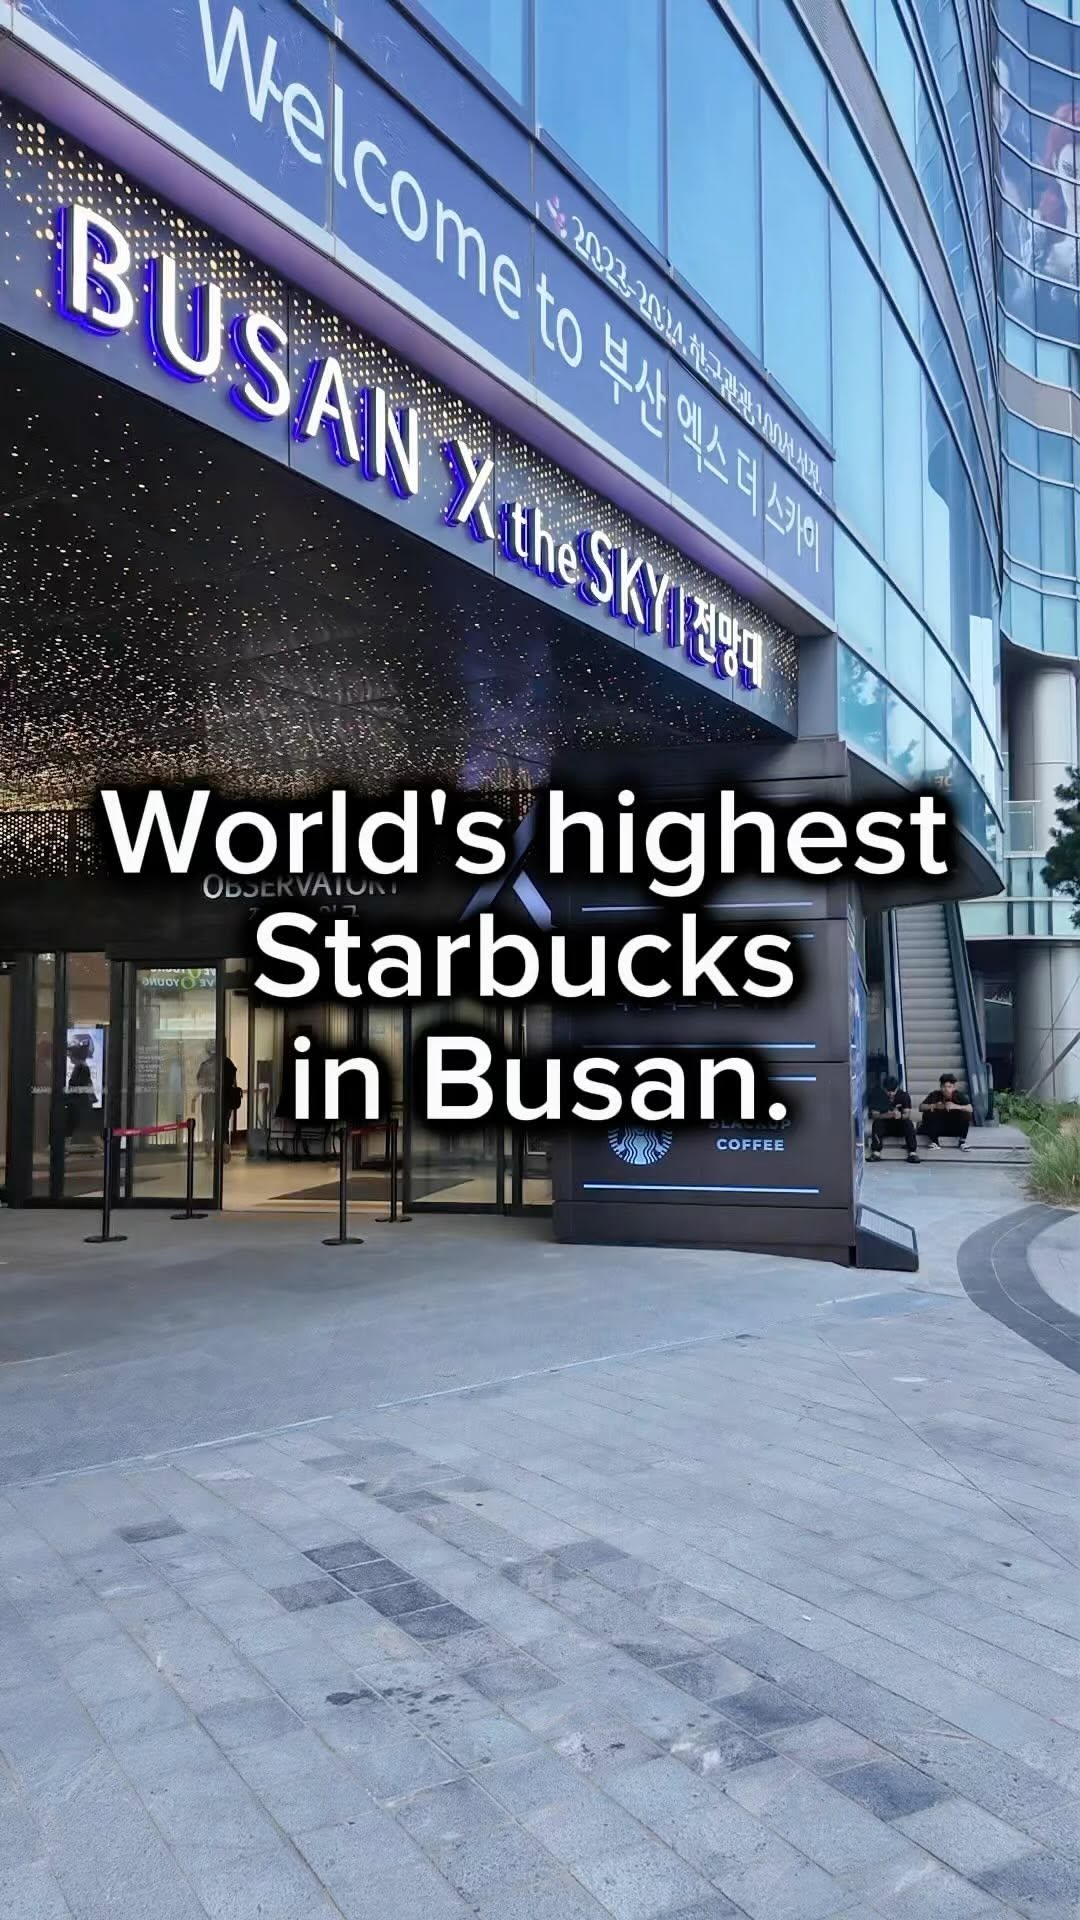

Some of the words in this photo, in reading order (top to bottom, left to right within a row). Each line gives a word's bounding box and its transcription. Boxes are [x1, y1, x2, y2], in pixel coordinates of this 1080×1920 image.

[65, 203, 418, 497] BUSAN
[448, 439, 495, 540] X
[505, 501, 578, 586] the
[584, 530, 670, 634] SKY
[692, 596, 763, 689] 전망대
[199, 0, 523, 320] Welcome
[536, 271, 583, 368] to
[599, 321, 667, 439] 부산
[676, 393, 729, 485] 엑스
[736, 448, 758, 518] 더
[764, 481, 819, 573] 스카이
[571, 215, 688, 355] 2023-2024
[688, 332, 755, 428] 한국관광
[716, 1138, 785, 1151] COFFEE
